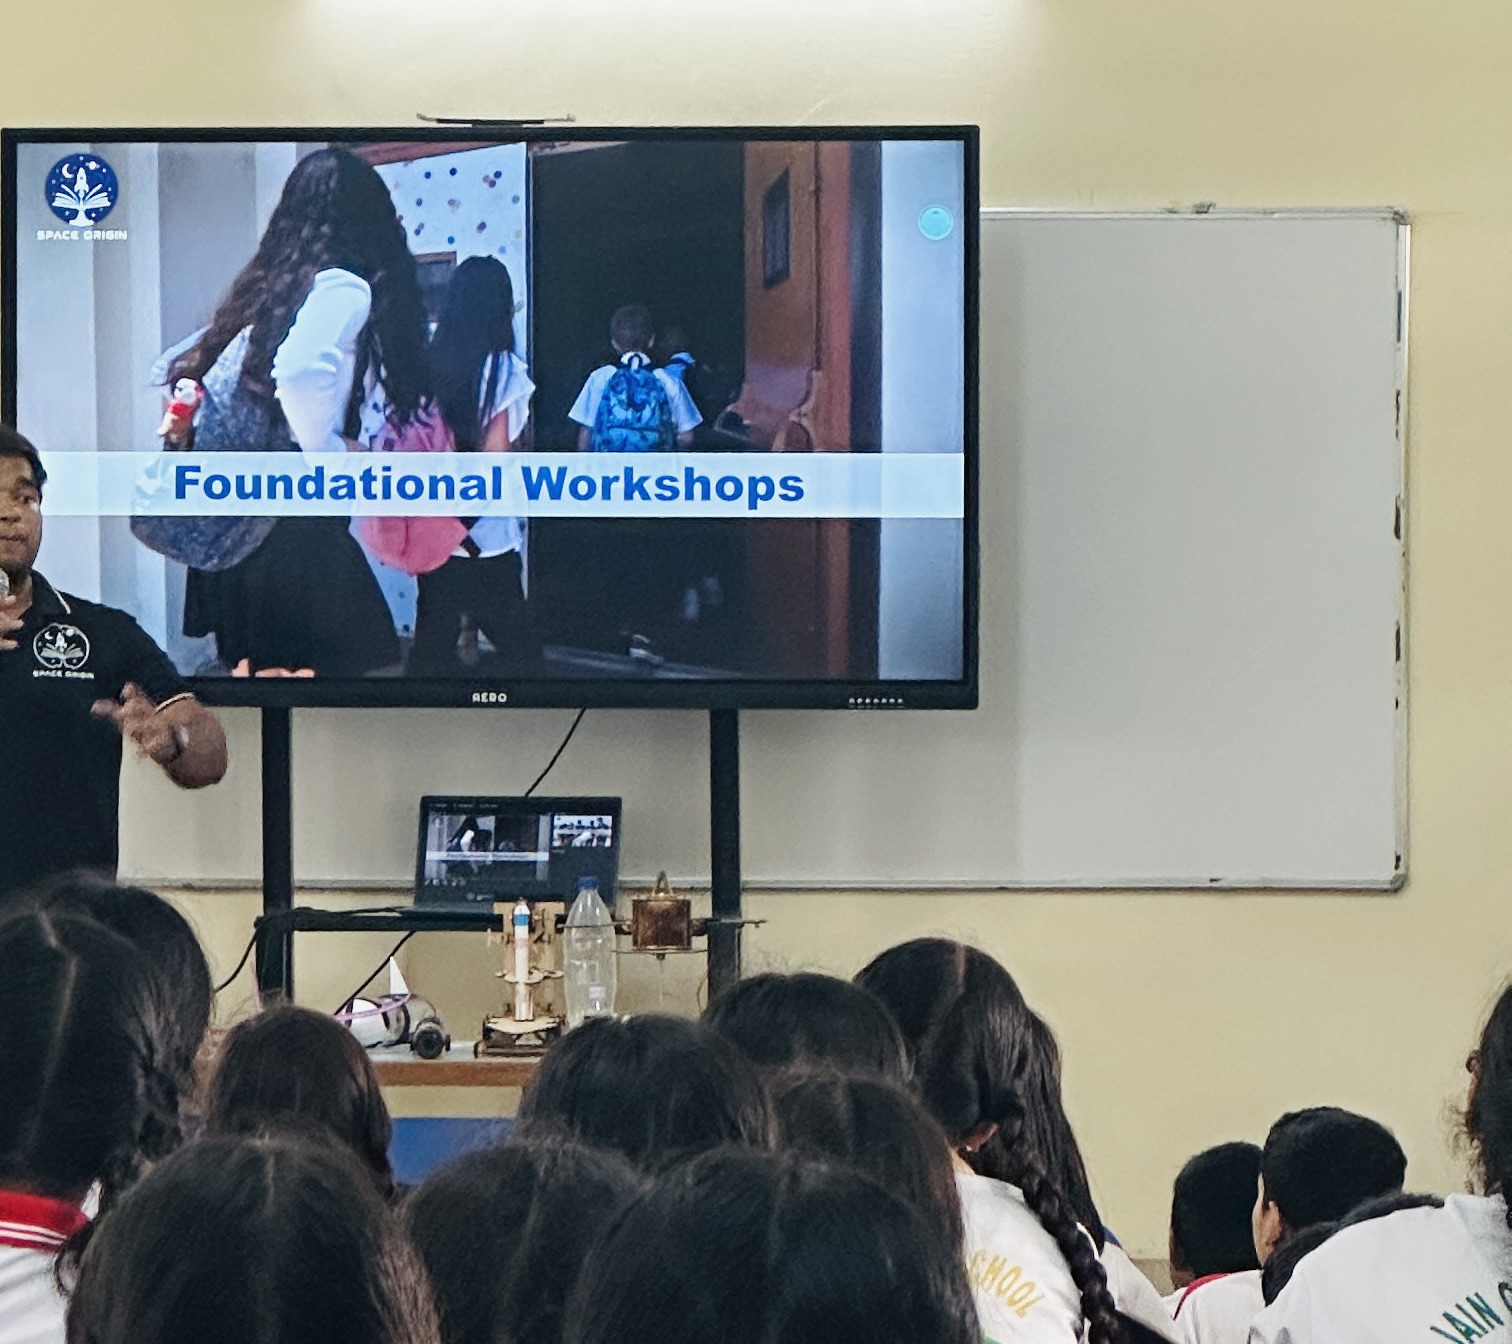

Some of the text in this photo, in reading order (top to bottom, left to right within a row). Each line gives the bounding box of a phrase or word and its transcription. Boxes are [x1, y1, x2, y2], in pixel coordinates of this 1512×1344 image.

[36, 229, 128, 241] SPACE ORIGIN
[175, 465, 804, 510] Foundational Workshops
